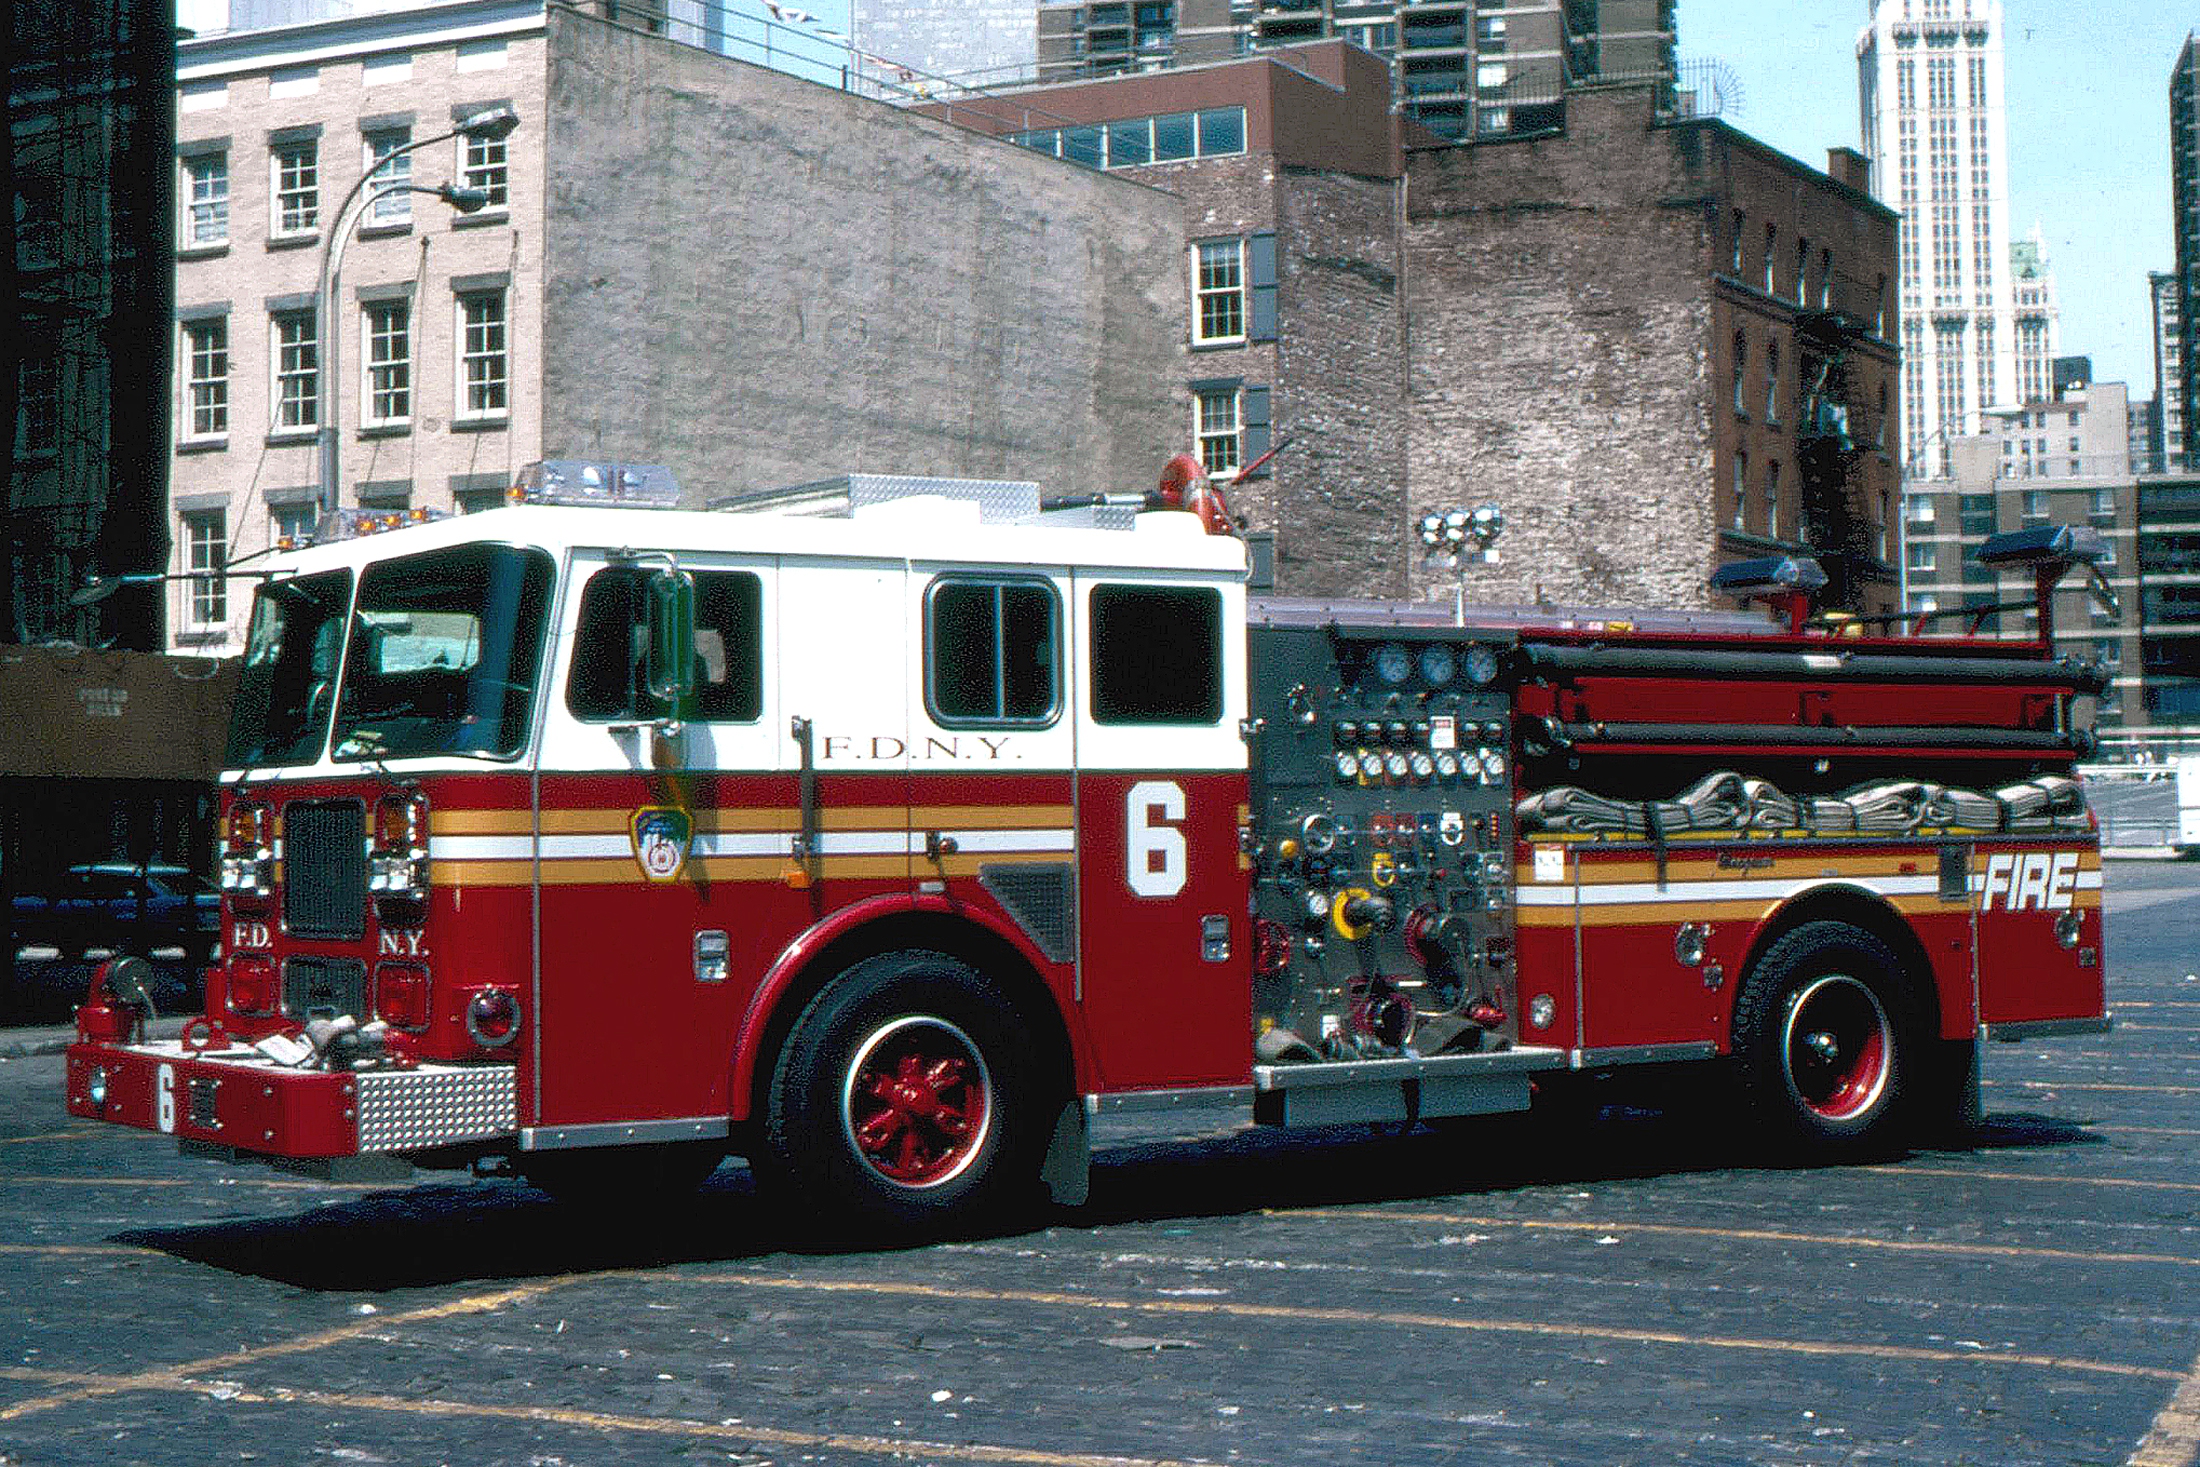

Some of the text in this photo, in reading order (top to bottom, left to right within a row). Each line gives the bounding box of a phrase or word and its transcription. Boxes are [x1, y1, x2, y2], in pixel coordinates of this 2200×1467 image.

[822, 736, 1022, 759] F.D.N.Y.
[1126, 781, 1187, 896] 6
[1981, 851, 2079, 912] FIRE
[377, 928, 430, 957] N.Y.
[158, 1063, 174, 1133] 6
